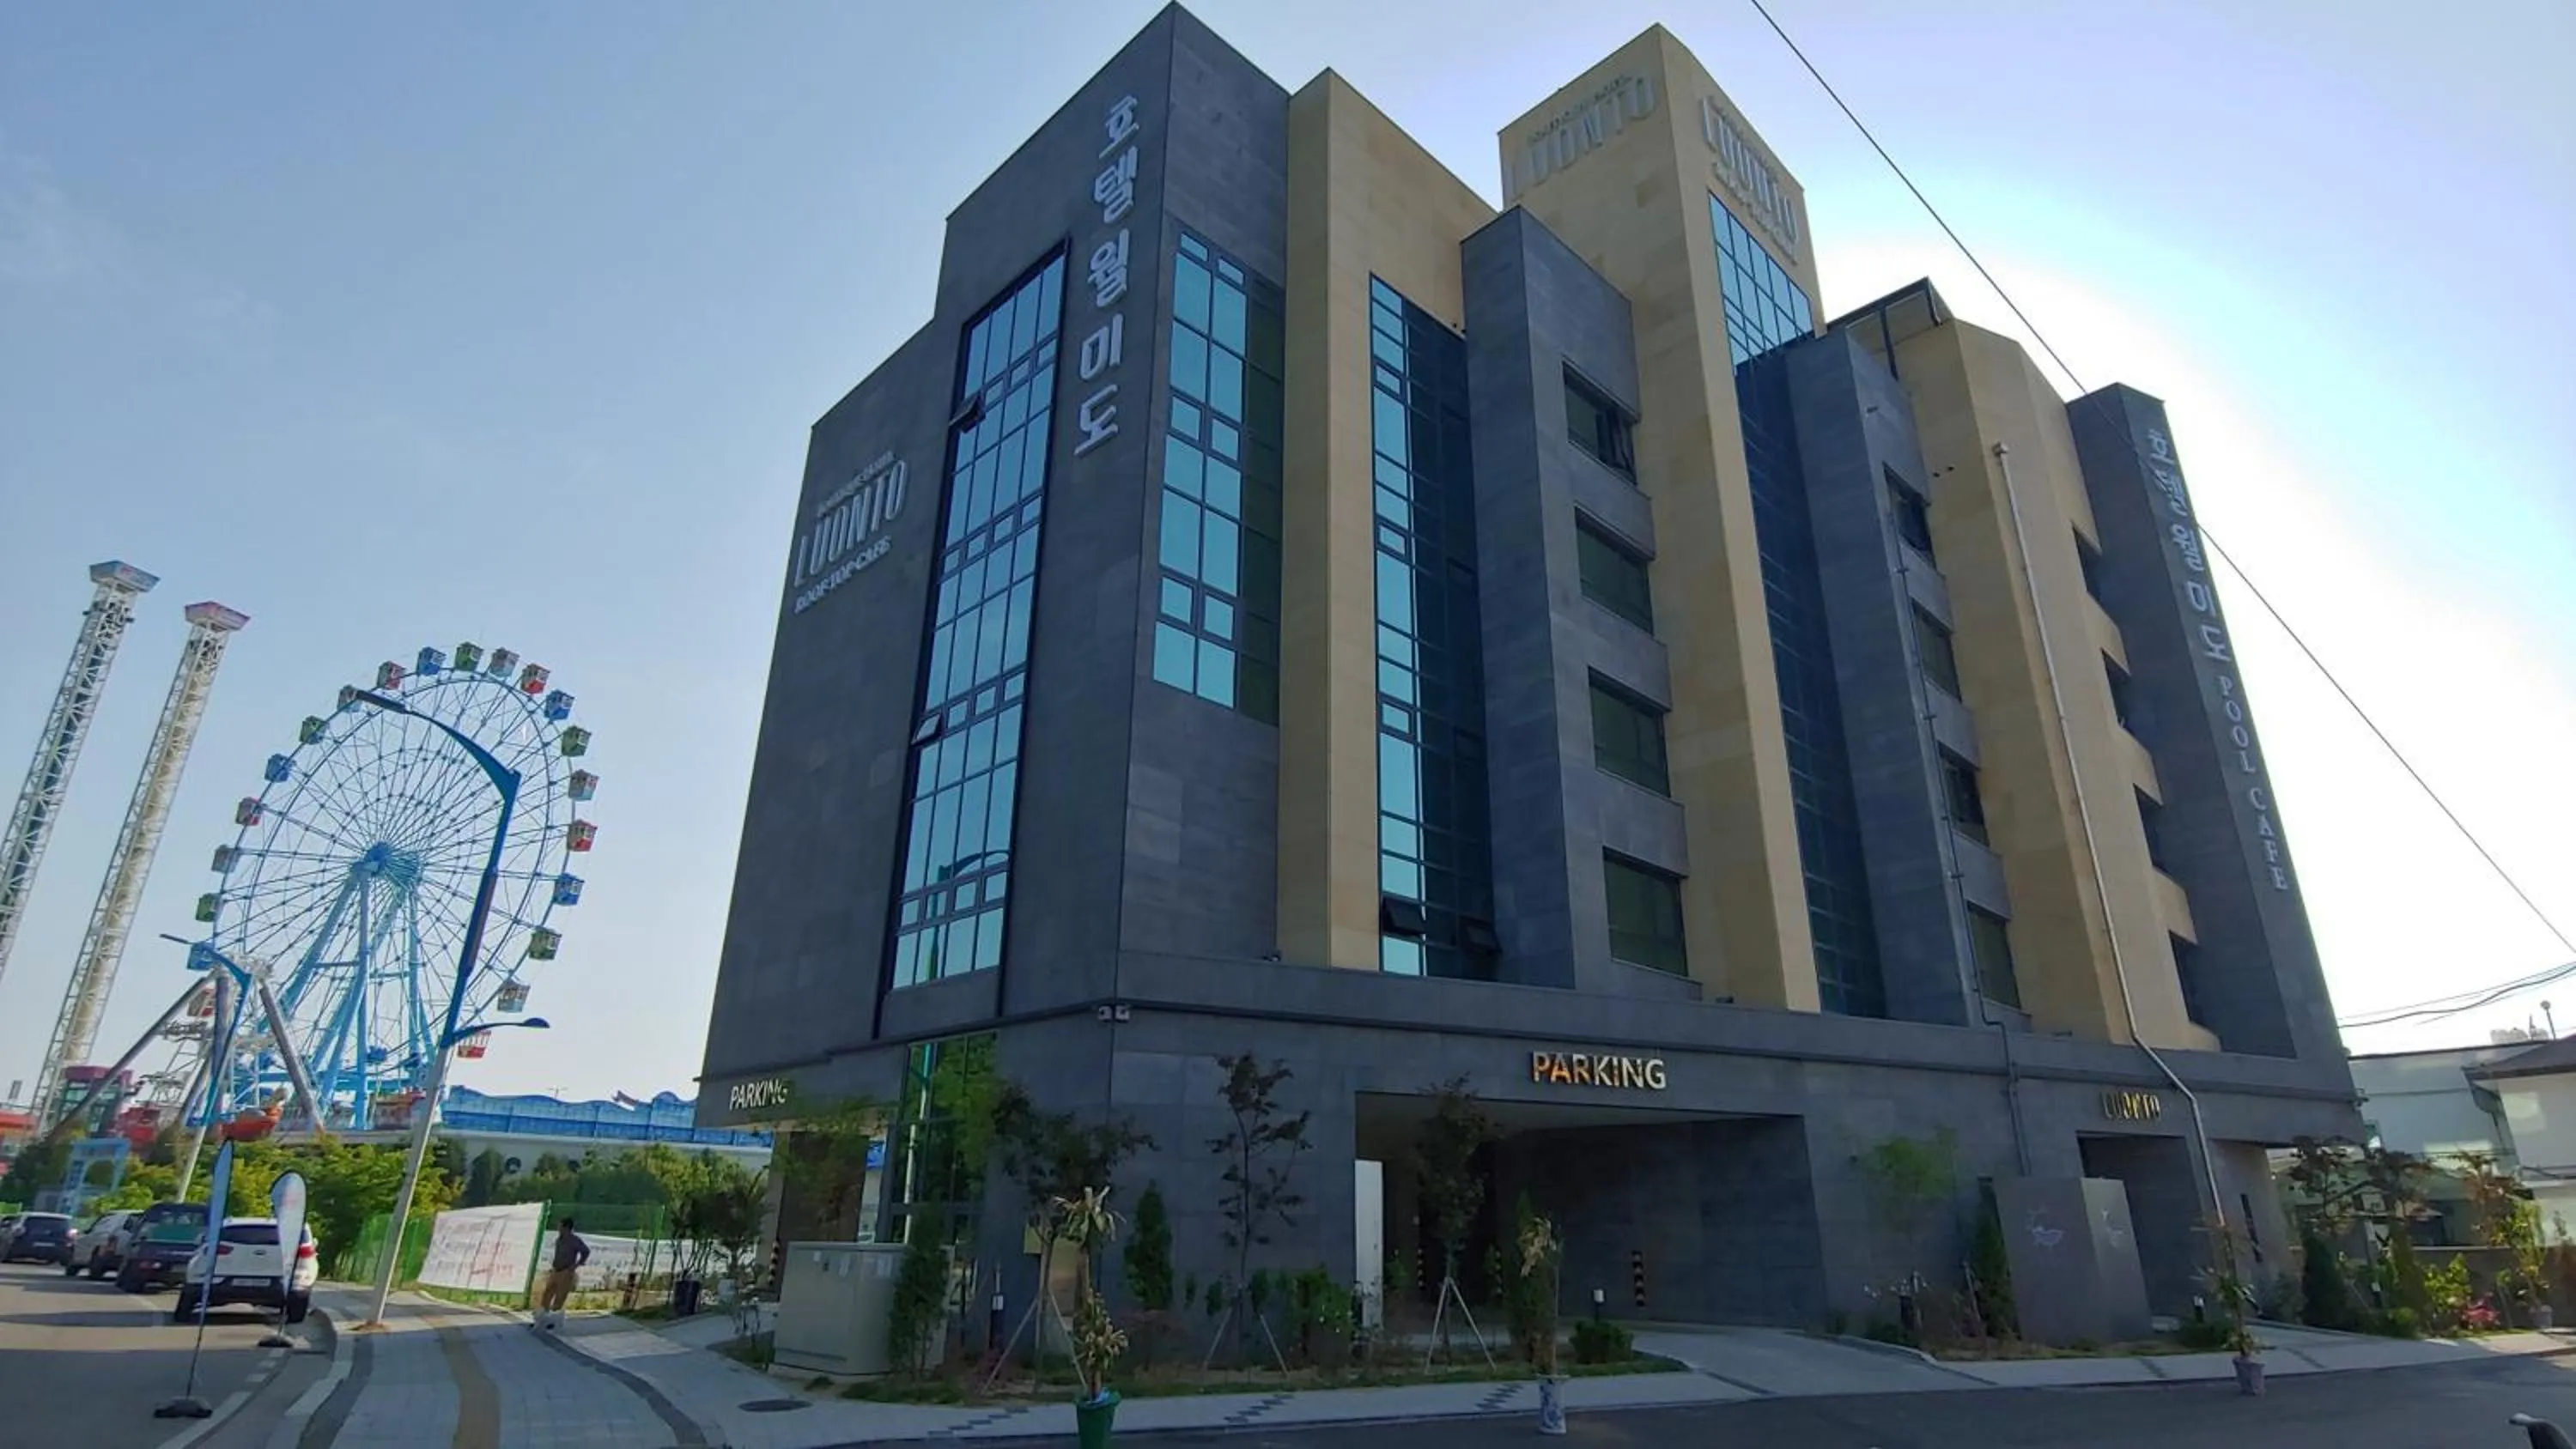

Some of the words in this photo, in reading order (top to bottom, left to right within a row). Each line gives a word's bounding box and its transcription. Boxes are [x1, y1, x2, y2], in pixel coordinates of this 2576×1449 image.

[2218, 675, 2257, 773] POOL
[2249, 787, 2288, 890] CAFE
[1532, 1050, 1668, 1090] PARKING
[728, 1078, 788, 1111] PARKING
